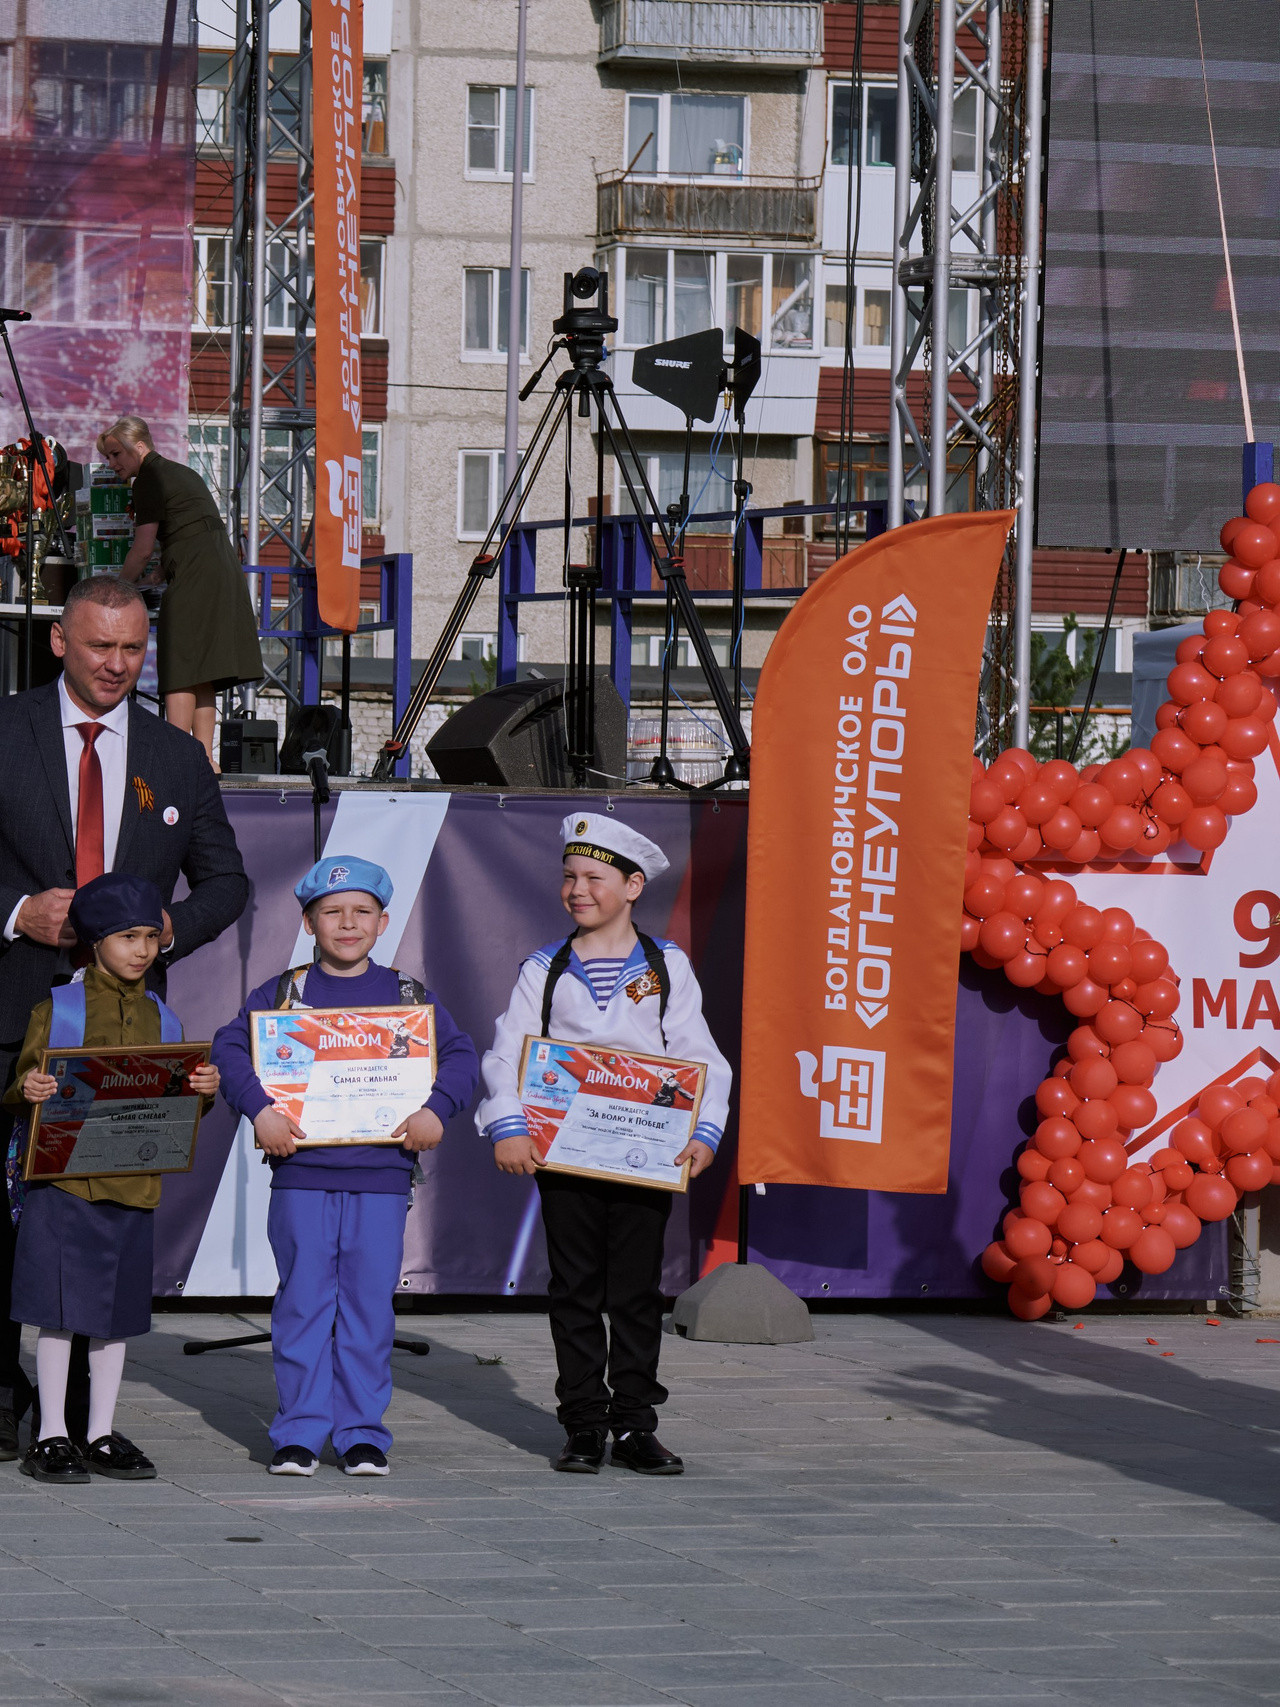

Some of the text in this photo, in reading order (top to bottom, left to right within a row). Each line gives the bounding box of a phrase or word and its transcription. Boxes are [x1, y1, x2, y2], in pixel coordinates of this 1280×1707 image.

[330, 31, 350, 412] БОГДАНОВИЧСКОЕ
[654, 357, 690, 369] SHURE
[824, 604, 872, 1011] БОГДАНОВИЧСКОЕ ОАО
[592, 849, 615, 864] ФЛОТ
[1233, 889, 1280, 968] 9
[318, 1032, 382, 1050] ДИПЛОМ
[100, 1073, 160, 1090] ДИПЛОМ
[585, 1069, 650, 1091] ДИПЛОМ
[608, 1104, 650, 1116] НАГРАЖДАЕТСЯ
